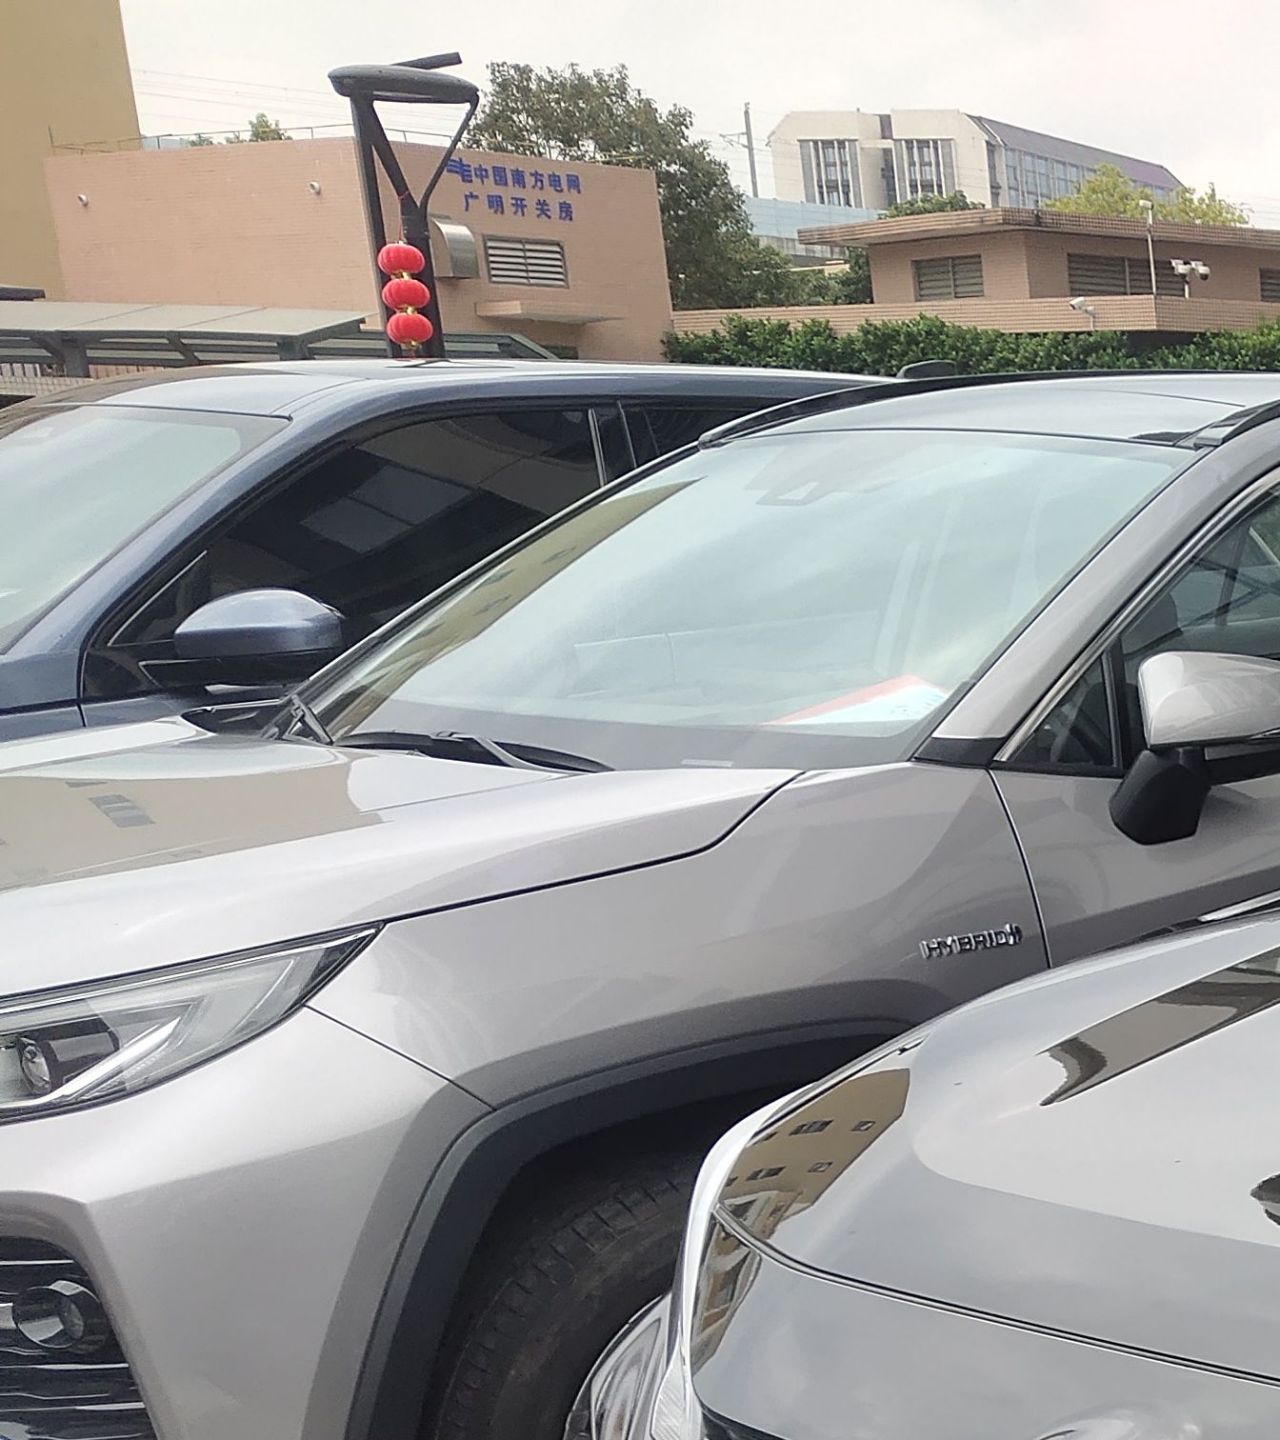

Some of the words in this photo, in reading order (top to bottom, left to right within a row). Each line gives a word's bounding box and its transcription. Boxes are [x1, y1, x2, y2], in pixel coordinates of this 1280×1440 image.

[474, 164, 582, 195] 中国南方电网
[464, 191, 574, 222] 广明开关房
[919, 929, 1007, 960] HYBRID
